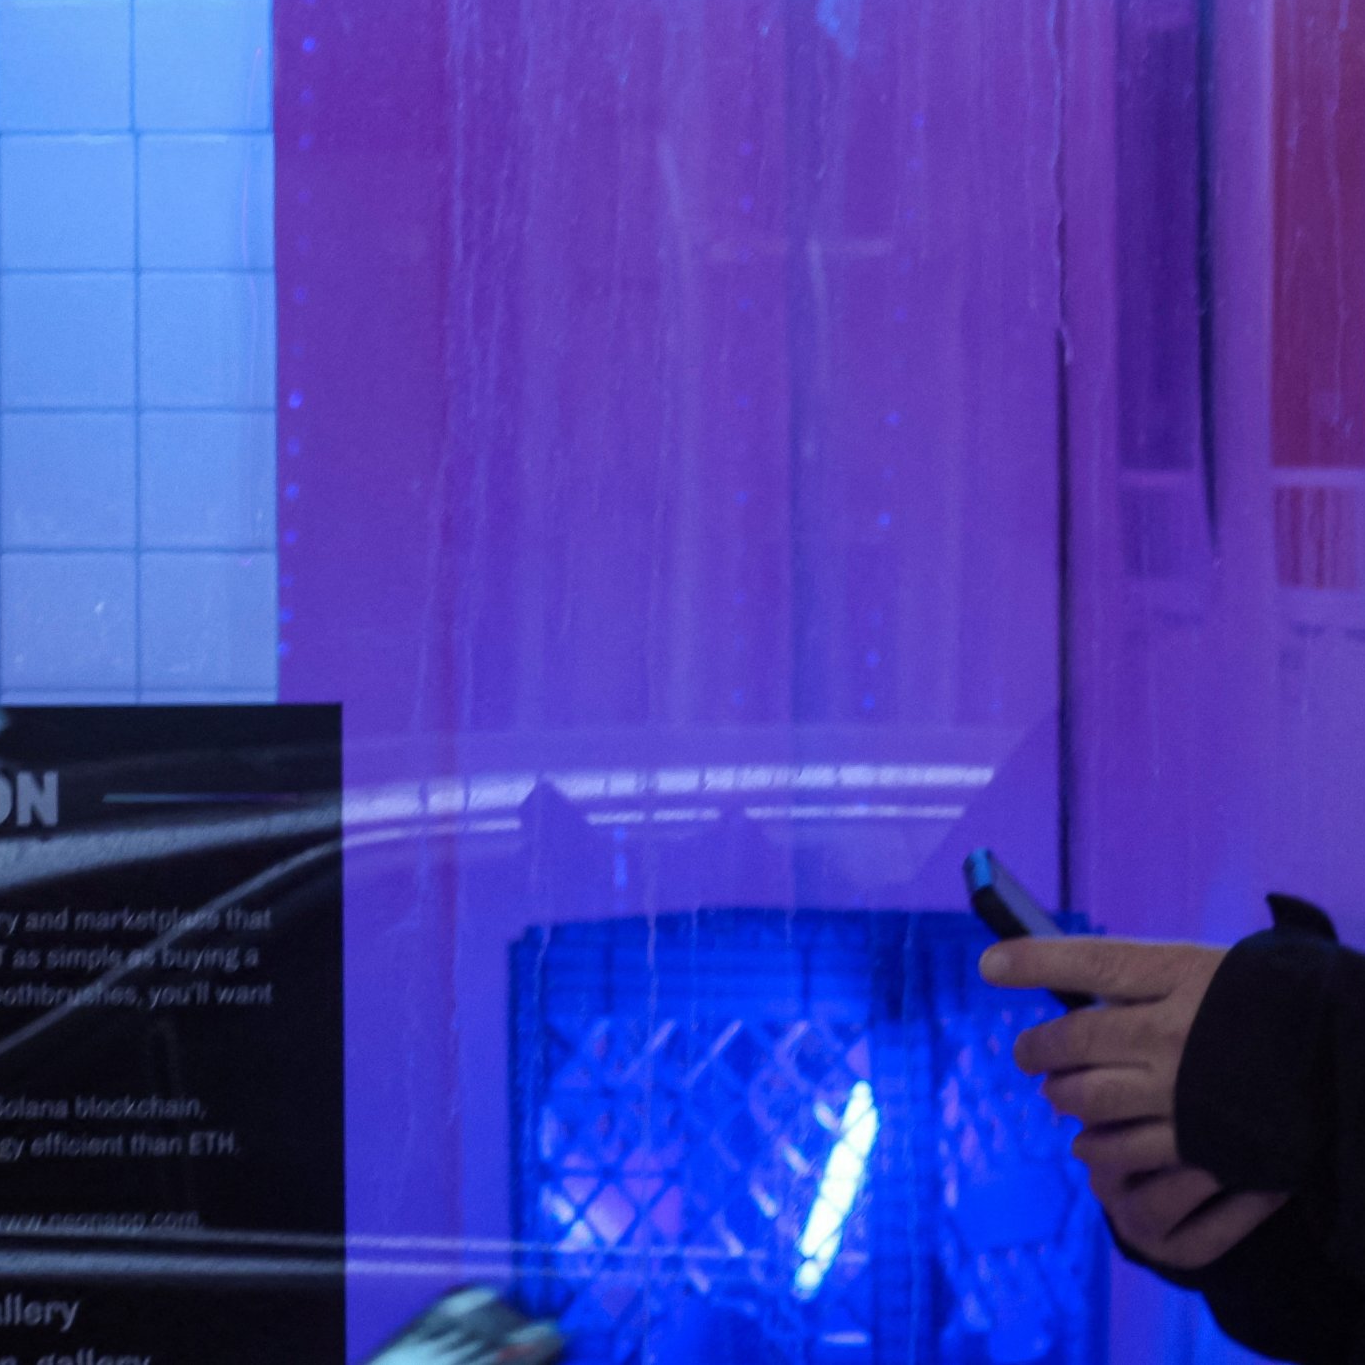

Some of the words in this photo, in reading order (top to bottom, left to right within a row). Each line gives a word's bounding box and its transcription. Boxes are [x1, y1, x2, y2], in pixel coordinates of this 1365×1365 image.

[26, 907, 68, 932] and
[226, 907, 272, 931] that
[12, 949, 41, 970] as
[46, 946, 123, 972] simple
[161, 947, 240, 973] buying
[245, 948, 260, 968] a
[149, 983, 211, 1011] you'll
[216, 984, 273, 1005] want
[74, 1095, 208, 1121] blockchain,
[30, 1132, 124, 1157] efficient
[129, 1133, 183, 1157] than
